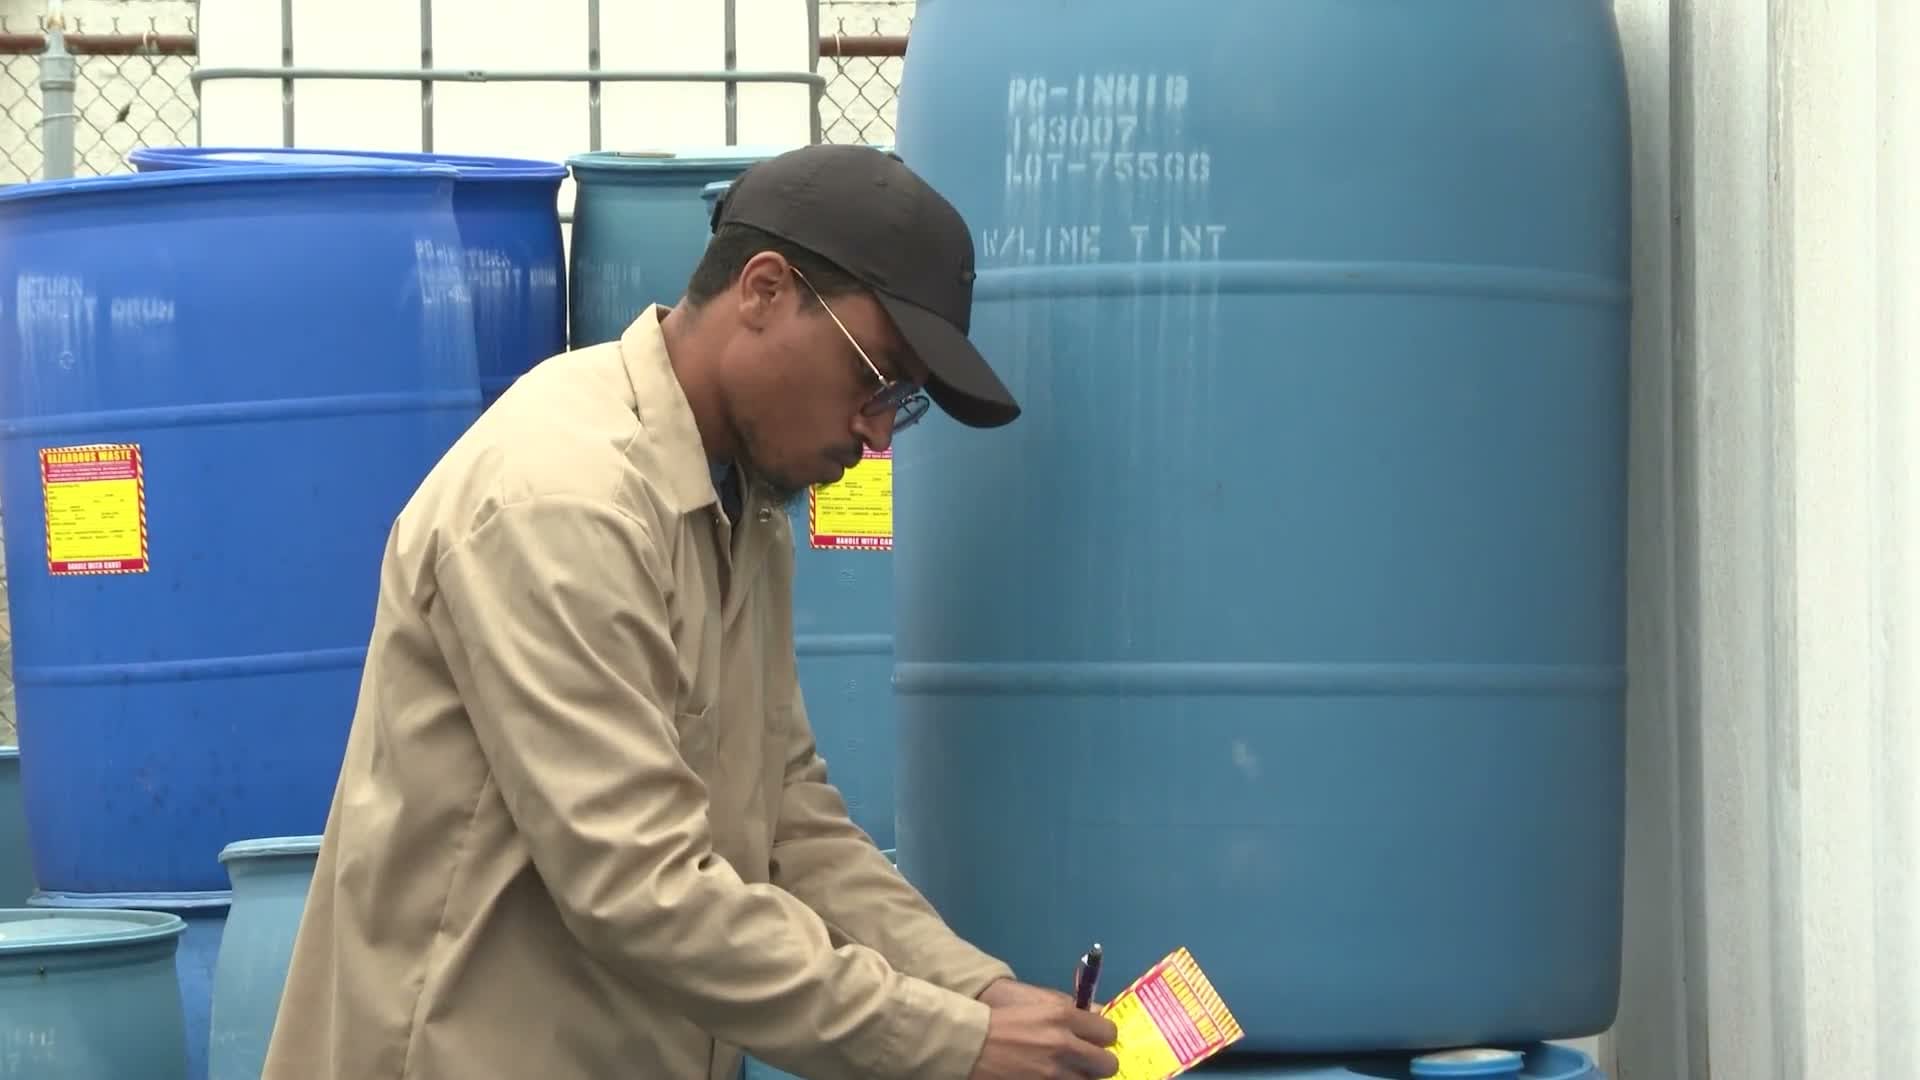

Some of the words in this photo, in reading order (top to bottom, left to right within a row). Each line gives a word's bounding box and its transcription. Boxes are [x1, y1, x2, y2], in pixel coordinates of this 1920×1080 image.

[1130, 224, 1227, 262] TINT
[47, 451, 97, 464] HAZARDOUS
[98, 449, 131, 462] WASTE
[836, 537, 860, 545] HANDLE
[861, 537, 879, 545] WITH
